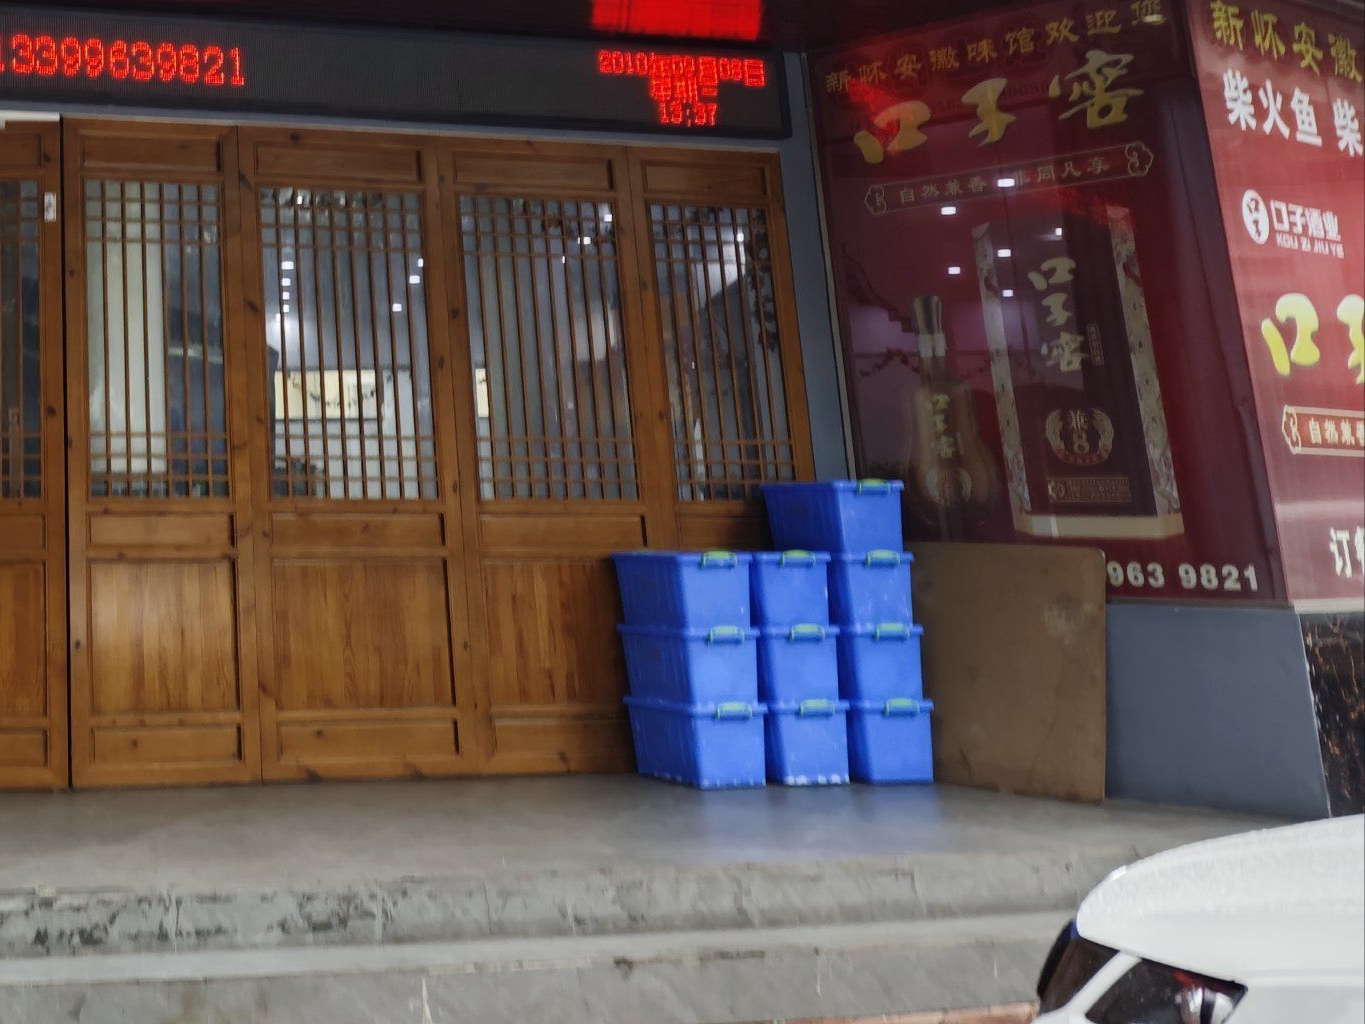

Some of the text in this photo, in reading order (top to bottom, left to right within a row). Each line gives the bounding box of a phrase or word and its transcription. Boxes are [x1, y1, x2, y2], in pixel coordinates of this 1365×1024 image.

[853, 48, 1145, 164] 口子窖
[1222, 67, 1364, 157] 柴火鱼 柴
[1269, 198, 1341, 242] 口子酒业
[1027, 256, 1089, 373] 口子窖
[1178, 562, 1258, 592] 9821
